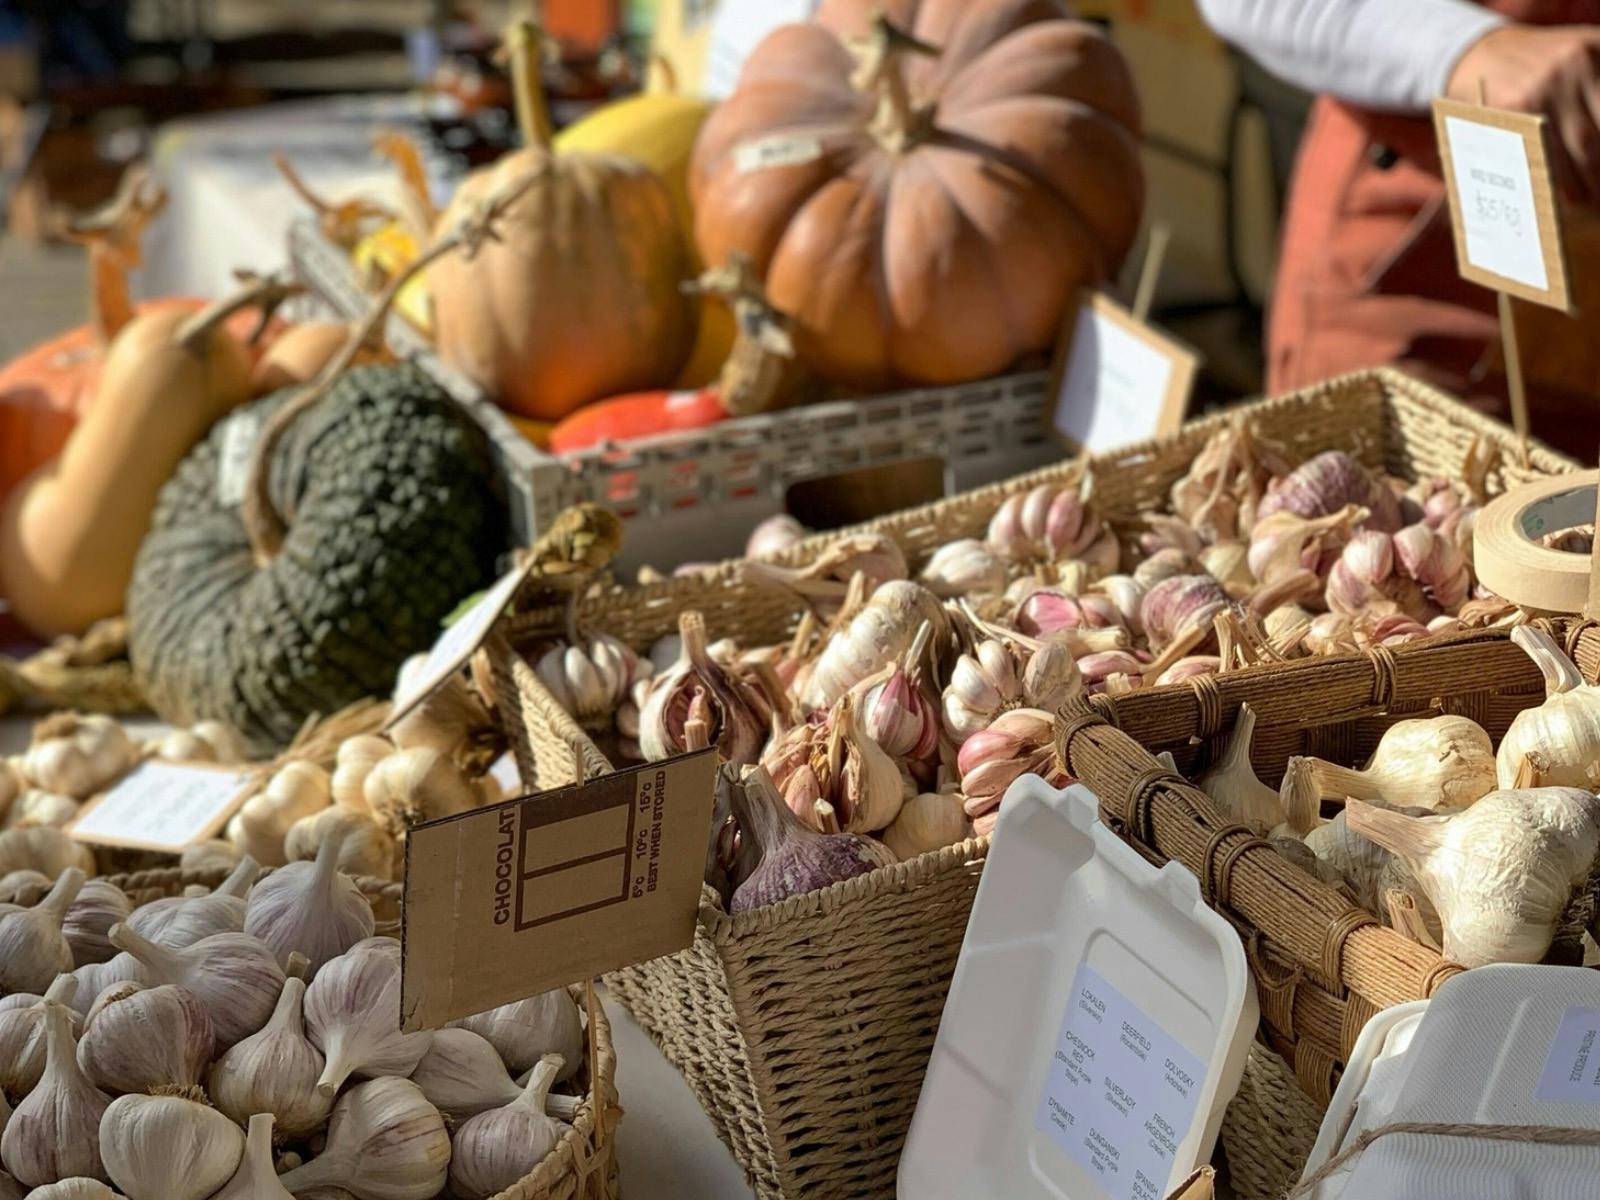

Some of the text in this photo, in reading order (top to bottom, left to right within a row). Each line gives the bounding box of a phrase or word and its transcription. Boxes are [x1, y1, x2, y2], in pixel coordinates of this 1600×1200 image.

[647, 770, 666, 892] BEST WHEN STORED
[494, 811, 515, 925] CHOCOLAT
[1081, 987, 1105, 1013] LOKALEN
[1121, 1020, 1152, 1052] DEERFIELD
[1072, 1049, 1084, 1064] RED
[1048, 1096, 1075, 1126] DYNAMITE
[1153, 1112, 1176, 1139] FRENCH
[1134, 1169, 1159, 1196] SPANISH
